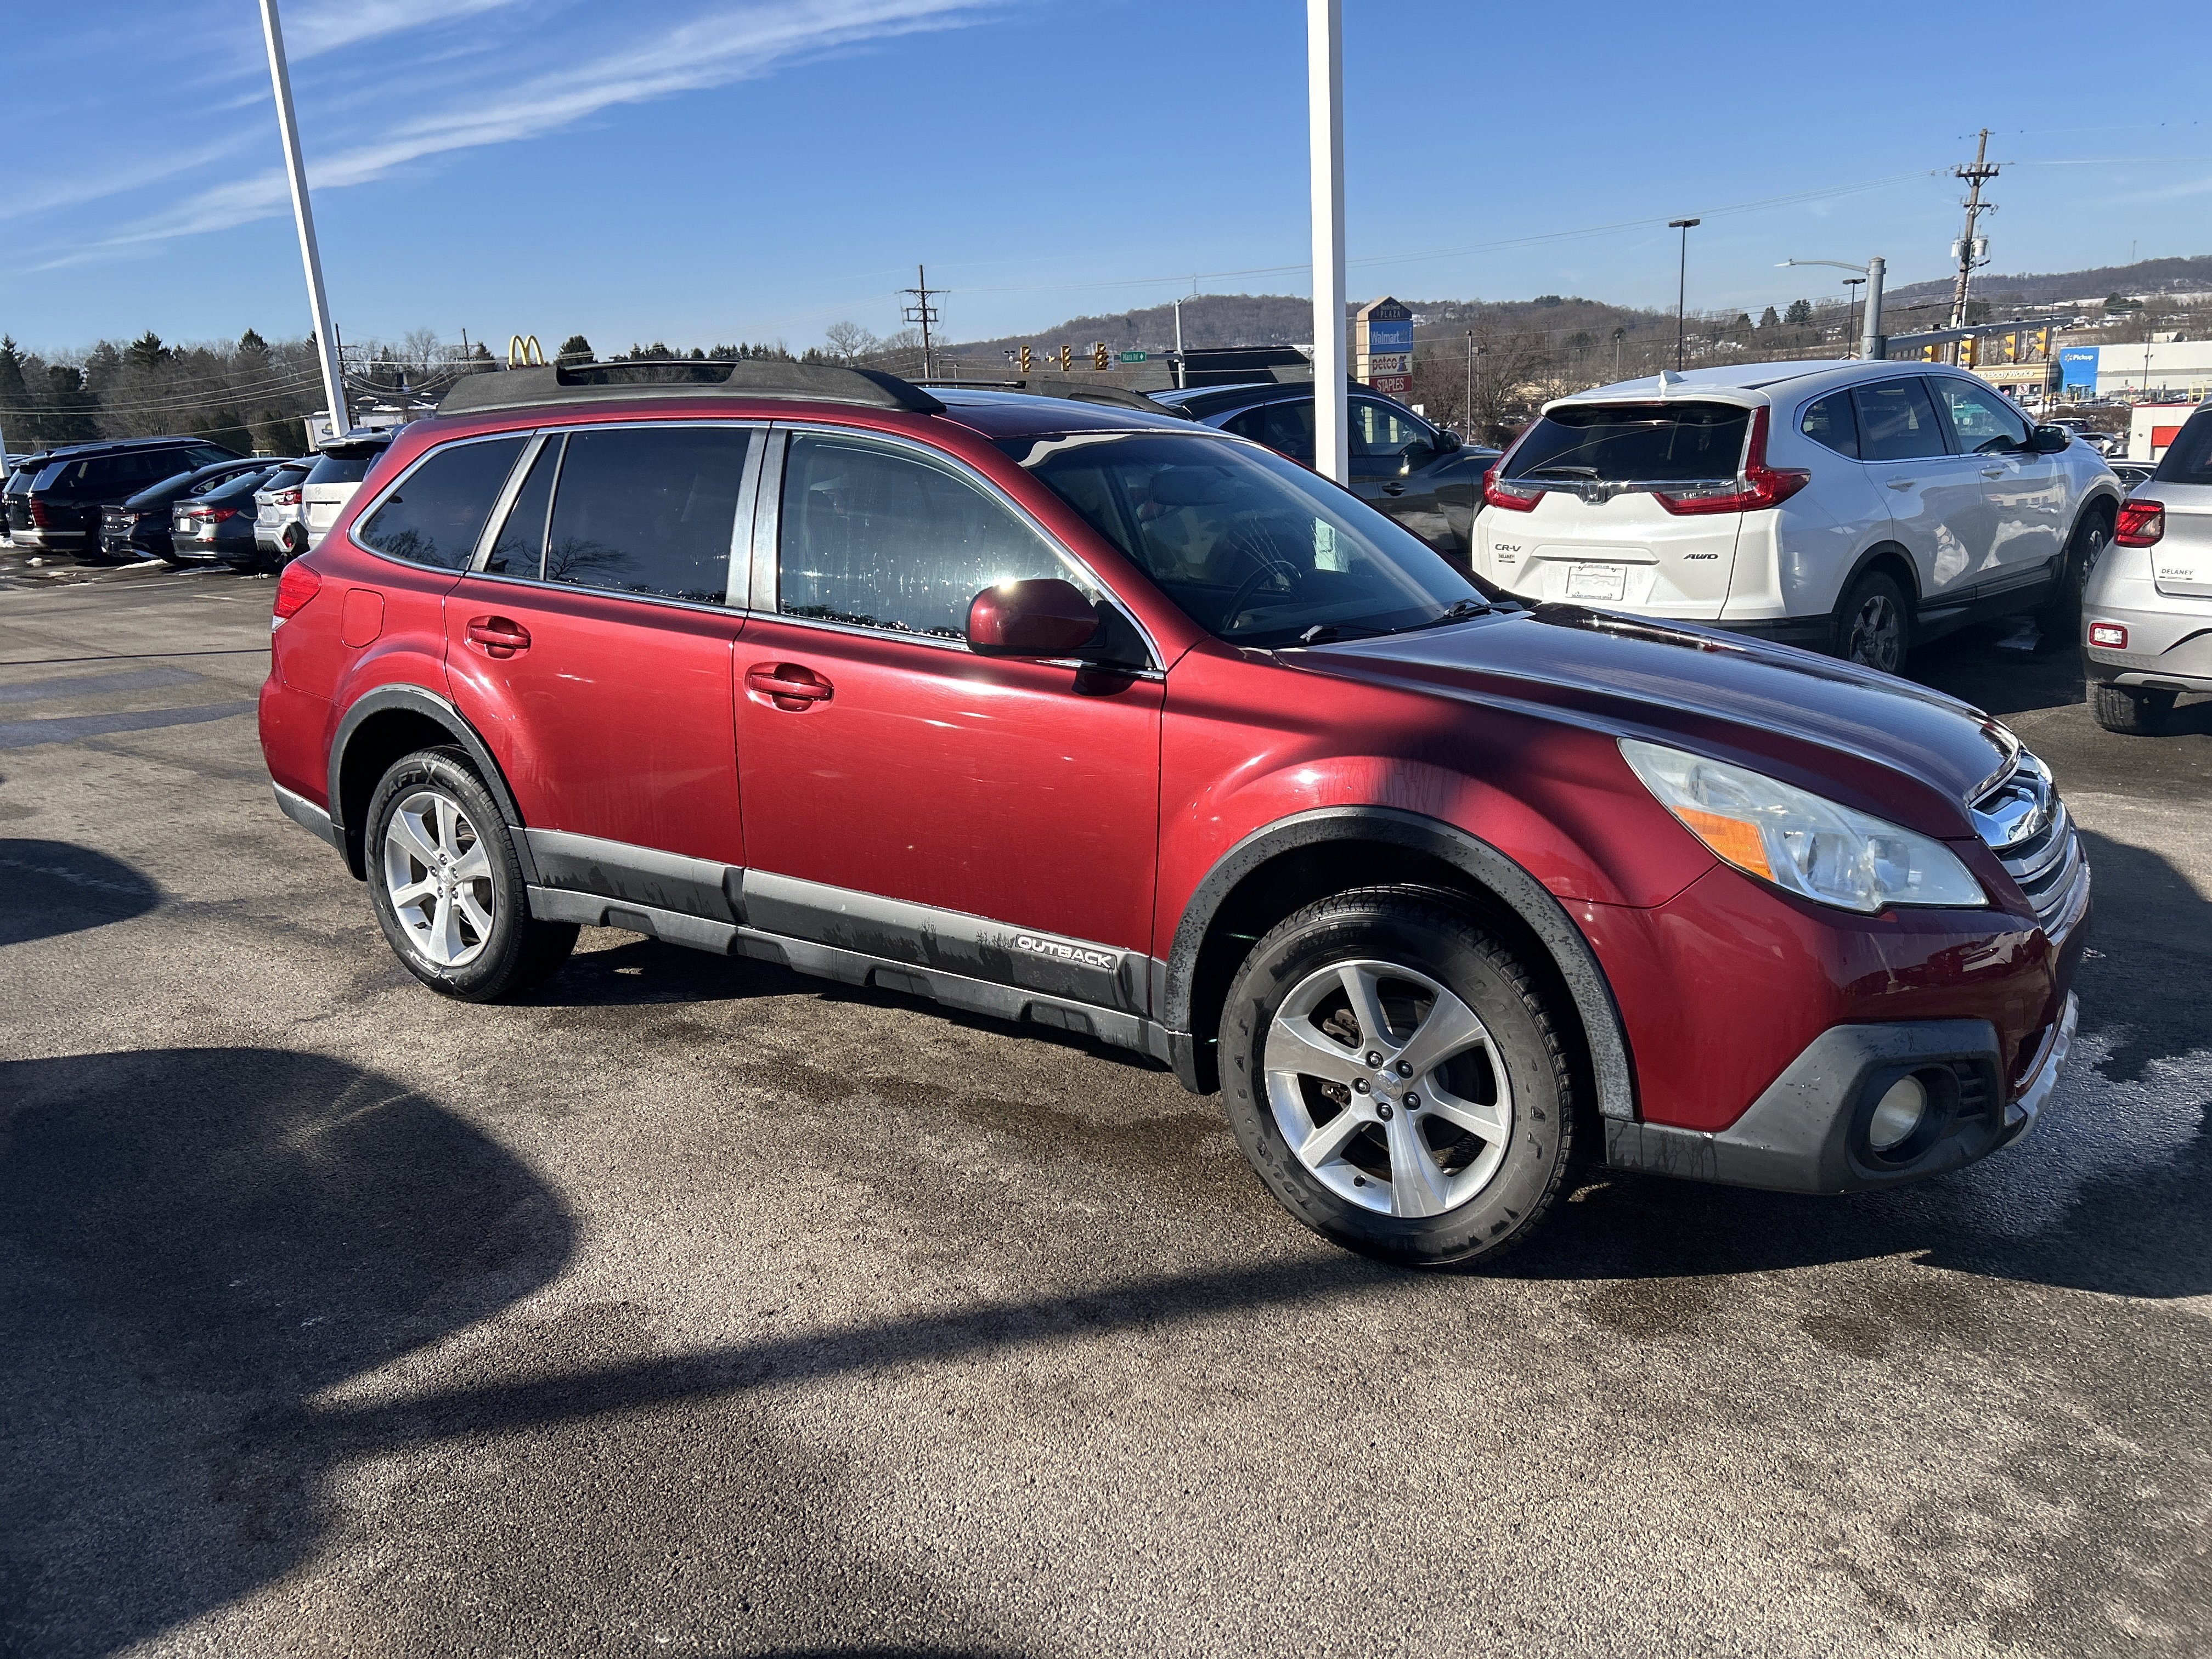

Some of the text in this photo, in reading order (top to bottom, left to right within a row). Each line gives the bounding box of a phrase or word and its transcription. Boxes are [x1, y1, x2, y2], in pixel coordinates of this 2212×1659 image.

[1371, 331, 1400, 344] Walmart
[1372, 357, 1397, 373] petco
[1988, 371, 2008, 379] Body
[1376, 377, 1404, 392] STAPLES
[1495, 544, 1521, 552] CR-V
[1018, 936, 1112, 968] OUTBACK
